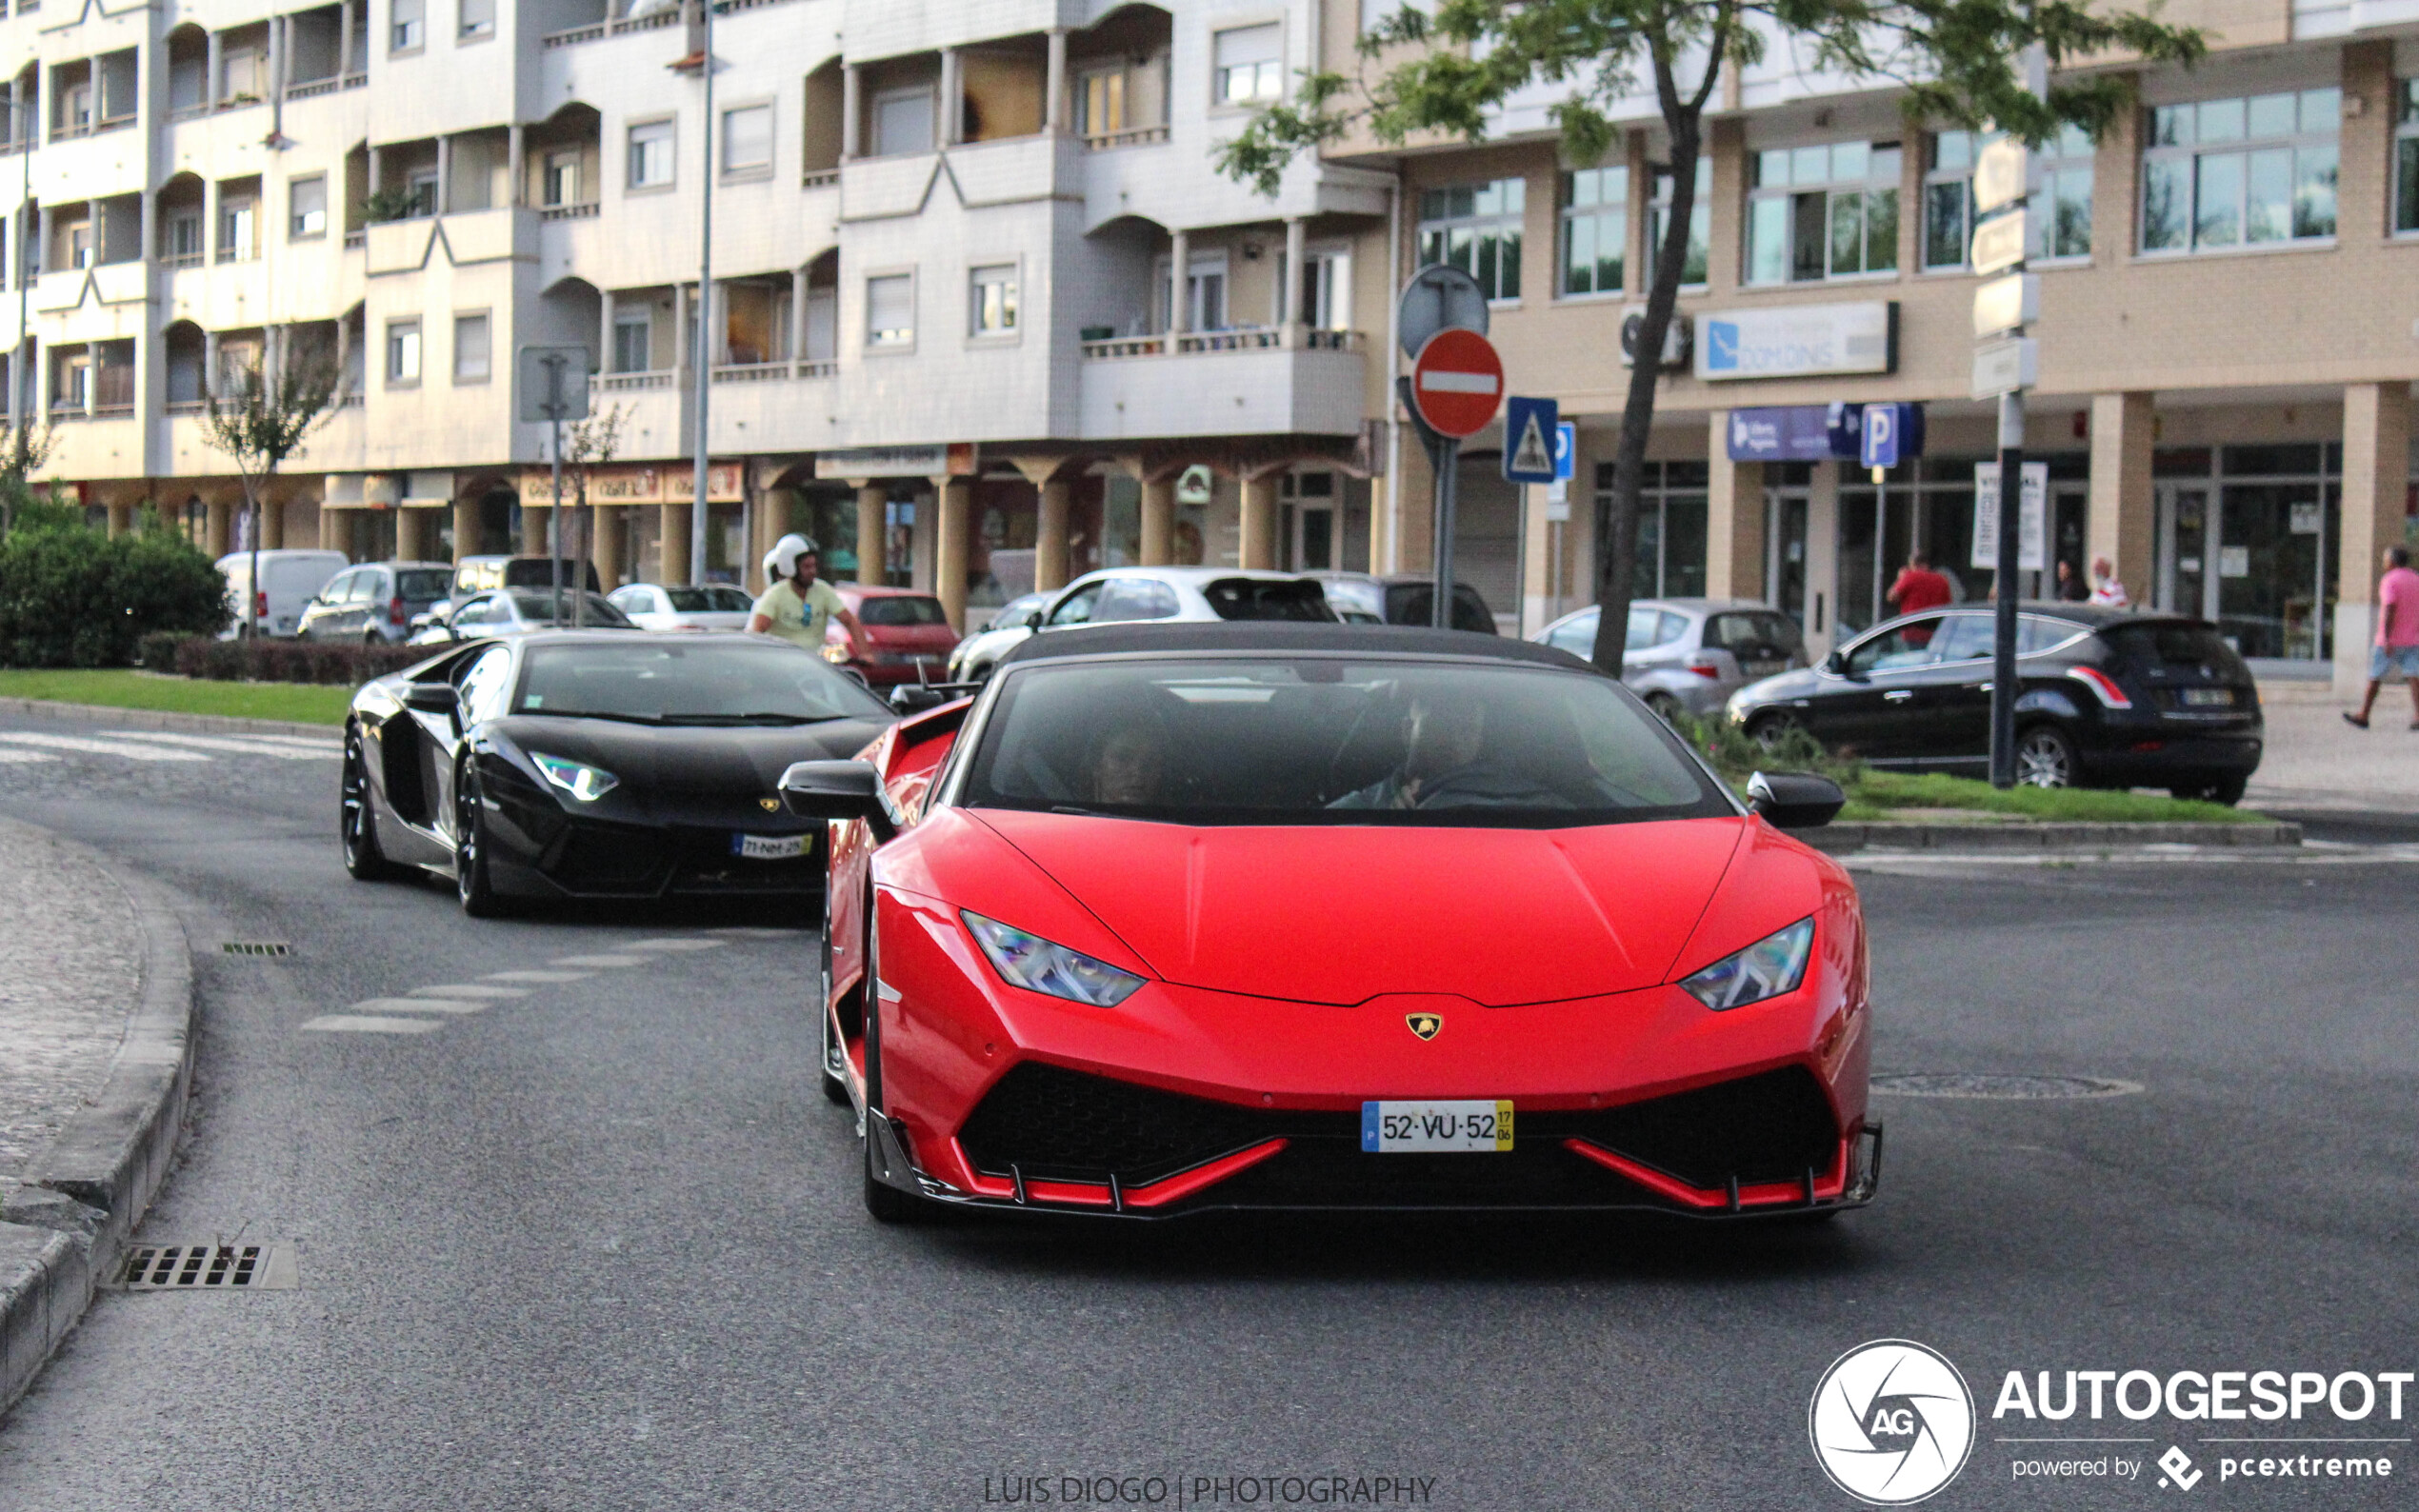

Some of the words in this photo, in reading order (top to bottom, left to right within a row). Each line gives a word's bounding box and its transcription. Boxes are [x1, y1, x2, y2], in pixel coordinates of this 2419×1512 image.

[1869, 412, 1890, 461] P
[1498, 1111, 1511, 1124] 17
[1498, 1128, 1511, 1141] 06
